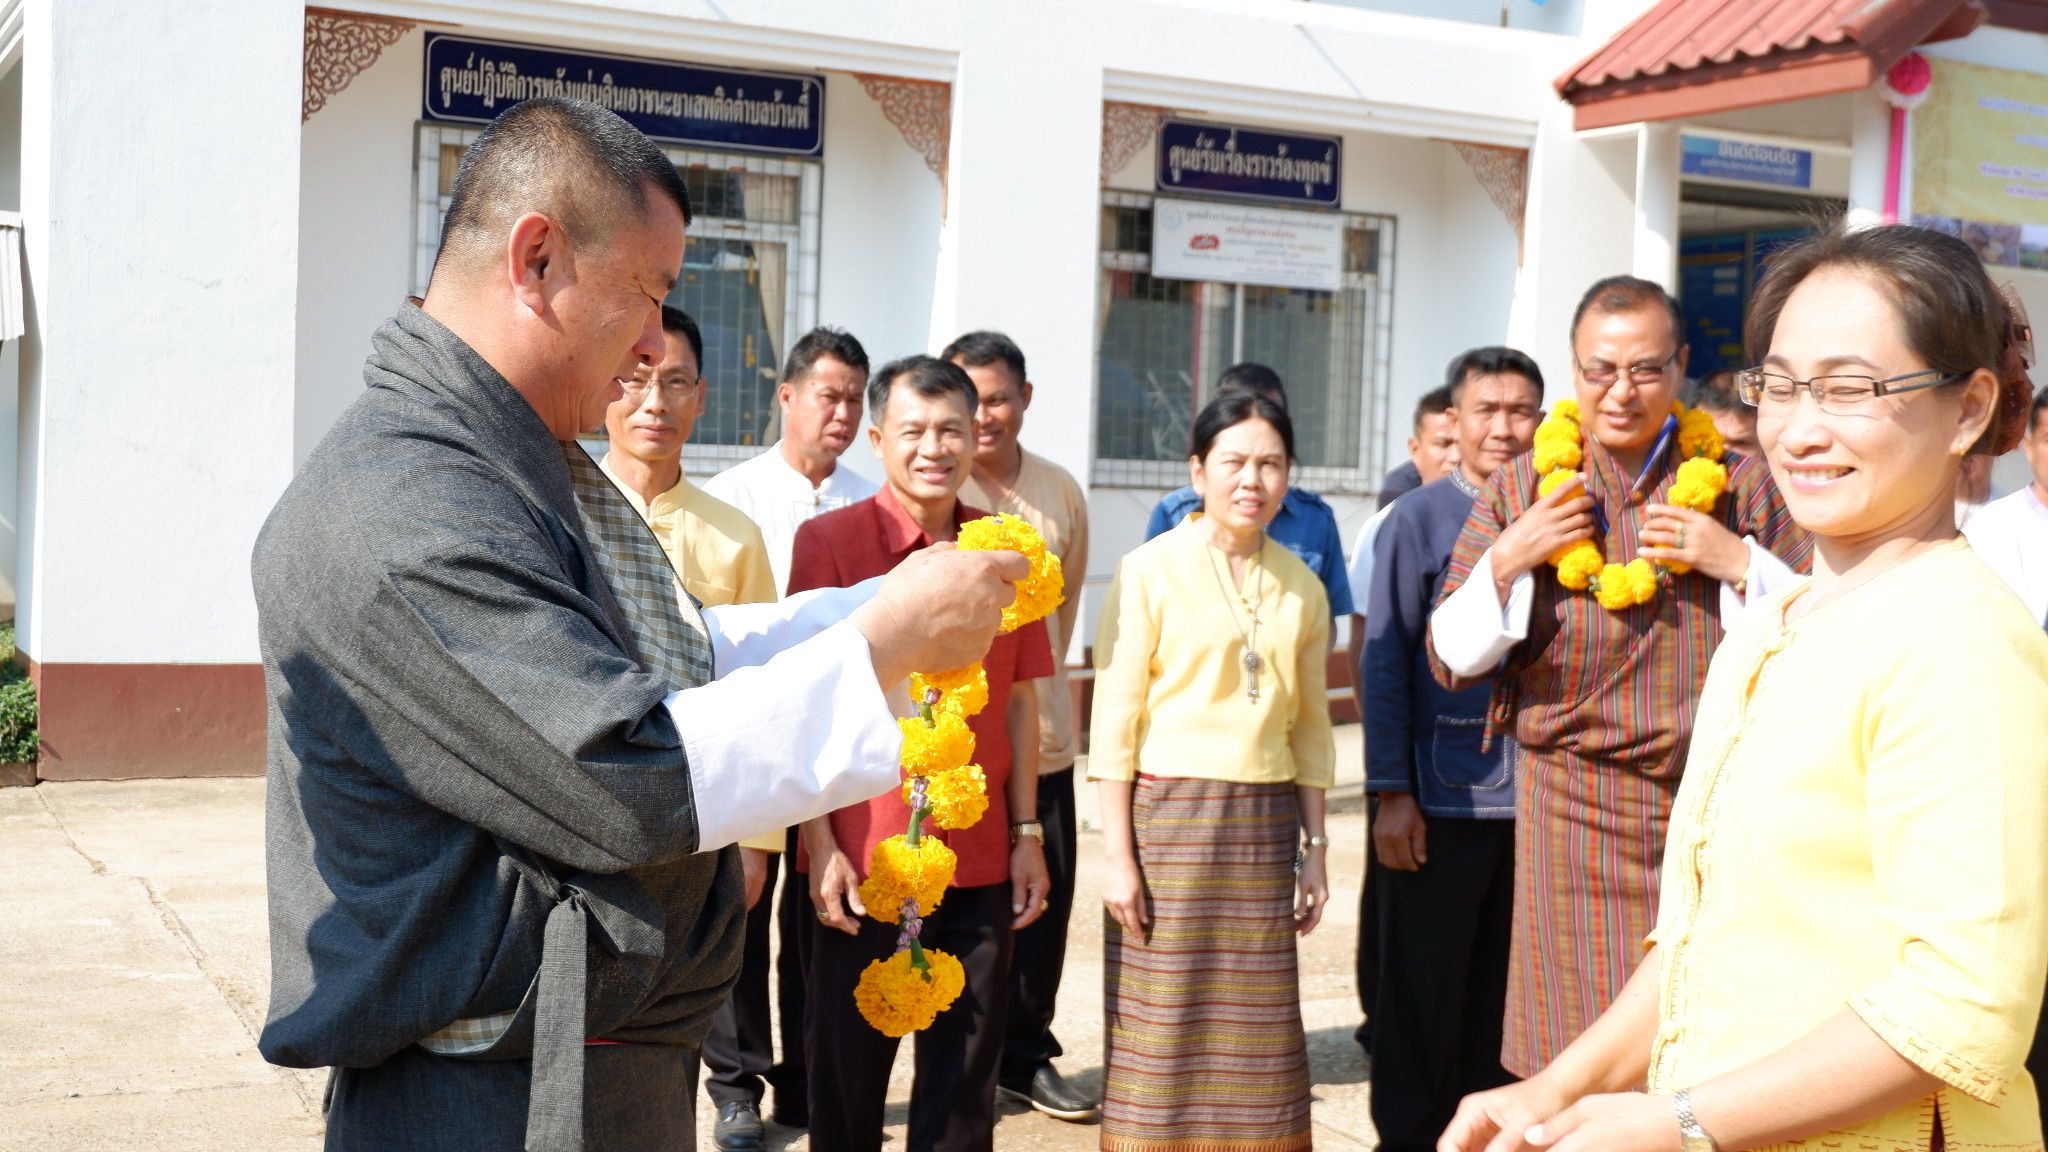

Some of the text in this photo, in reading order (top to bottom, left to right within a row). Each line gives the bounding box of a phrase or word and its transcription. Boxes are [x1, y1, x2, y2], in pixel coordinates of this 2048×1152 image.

[1169, 126, 1334, 197] ศูนย์รับเรื่องราวร้องทุกข์
